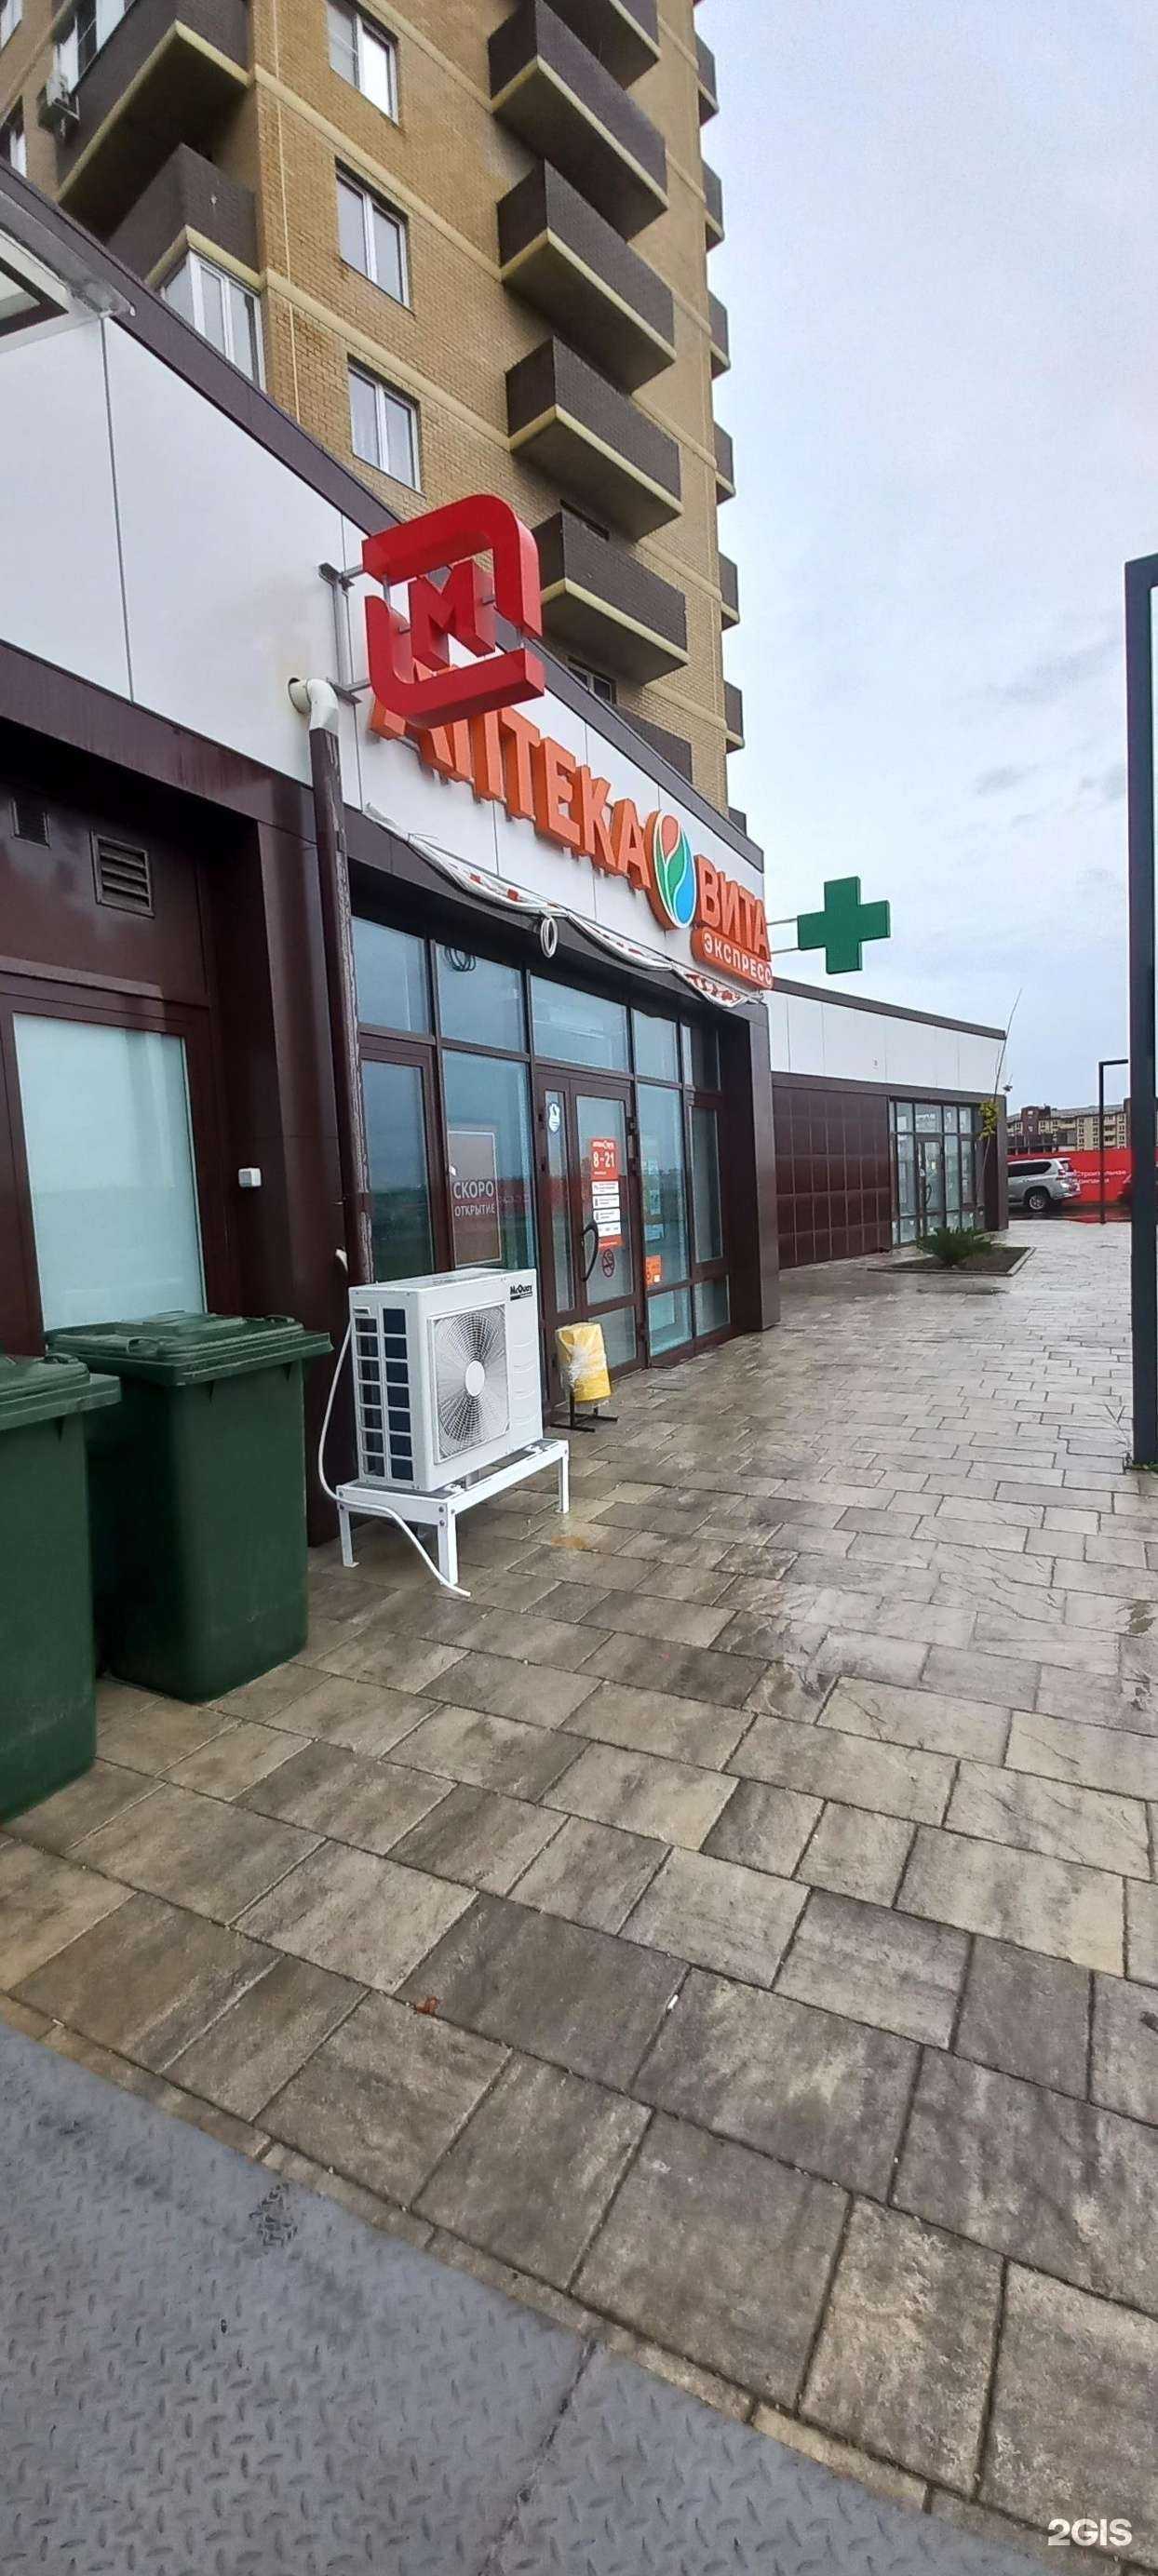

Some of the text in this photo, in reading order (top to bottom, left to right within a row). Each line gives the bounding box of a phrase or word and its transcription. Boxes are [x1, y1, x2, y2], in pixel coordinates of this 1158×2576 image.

[693, 853, 772, 962] ВИТА
[704, 932, 773, 986] ЭКСПРЕСС
[453, 1180, 494, 1200] СКОРО
[454, 1202, 496, 1217] ОТКРЫТИЕ
